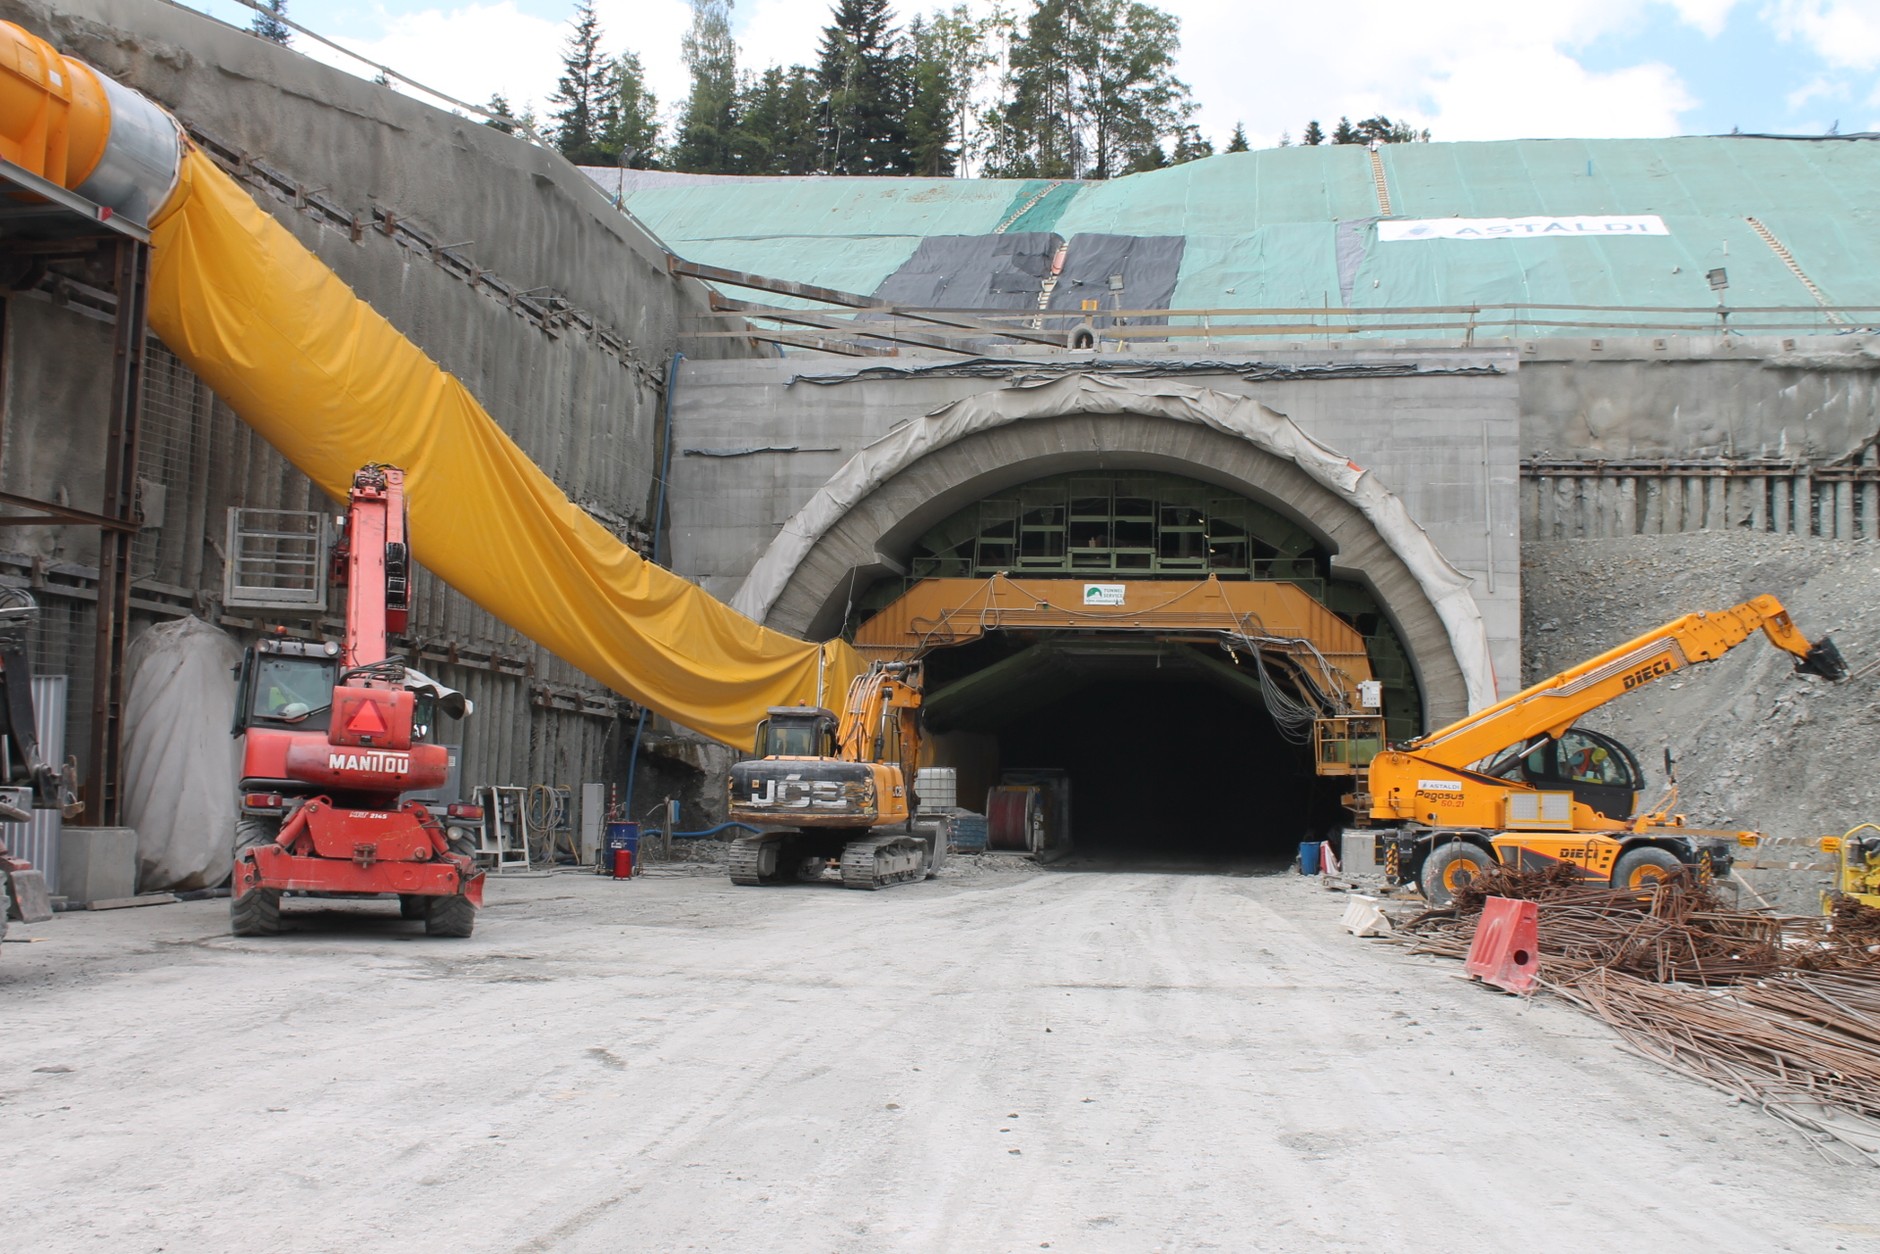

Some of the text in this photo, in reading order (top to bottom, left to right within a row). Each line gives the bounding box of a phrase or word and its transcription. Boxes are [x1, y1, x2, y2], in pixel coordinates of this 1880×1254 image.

[1455, 221, 1650, 236] ASTALDI
[328, 750, 410, 774] MANITOU
[751, 776, 848, 809] JCB
[1414, 789, 1465, 803] Pegasus
[1440, 799, 1465, 808] 50.21
